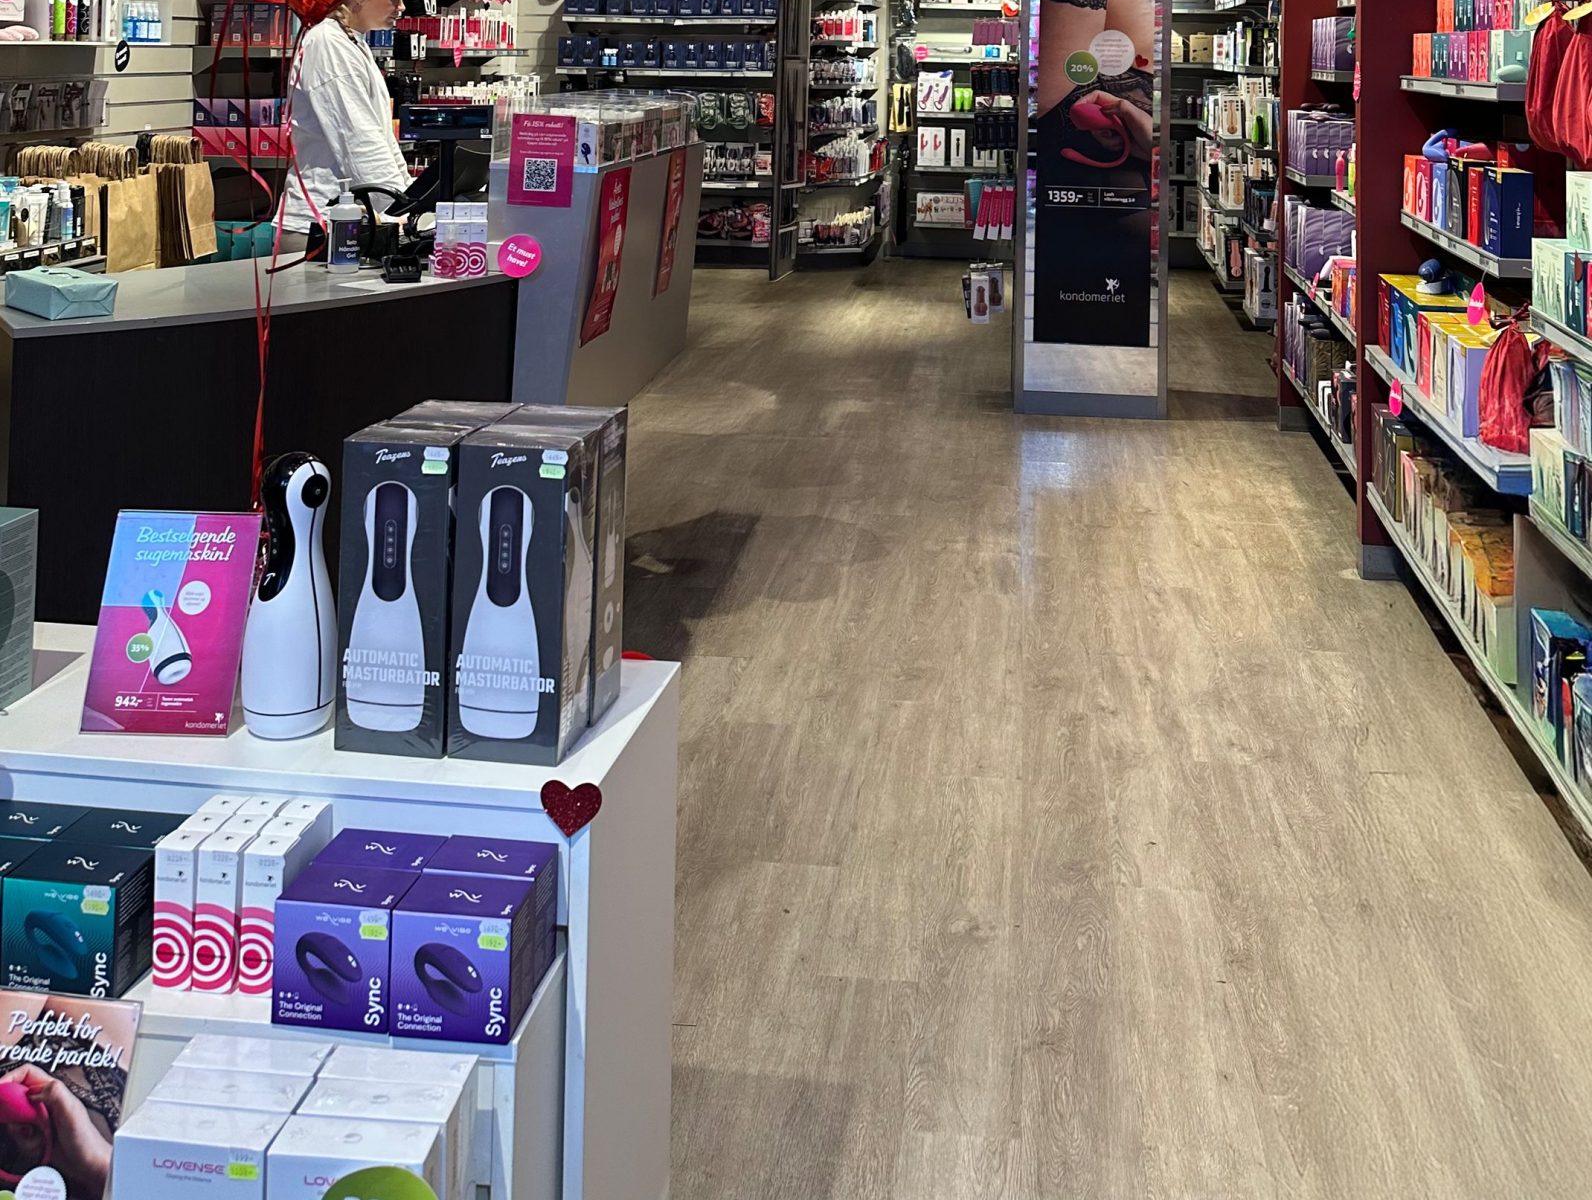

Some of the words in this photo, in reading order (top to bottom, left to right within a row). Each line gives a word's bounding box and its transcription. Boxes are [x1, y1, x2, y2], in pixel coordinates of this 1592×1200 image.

[1070, 64, 1094, 73] 20%
[1047, 190, 1084, 203] 1359,-
[507, 242, 517, 252] Et
[516, 248, 536, 260] must
[506, 253, 529, 268] have!
[1059, 290, 1126, 303] kondomeriet
[375, 448, 411, 465] Teazers
[490, 452, 528, 469] Teazers
[136, 526, 237, 548] Bestselgende
[135, 544, 235, 567] sugemaskin!
[343, 648, 419, 668] AUTOMATIC
[455, 653, 533, 674] AUTOMATIC
[342, 664, 440, 687] MASTURBATOR
[455, 670, 555, 694] MASTURBATOR
[185, 721, 227, 730] kondomeriet
[9, 973, 21, 984] The
[22, 975, 50, 986] Original
[90, 952, 110, 998] Sync
[279, 1000, 292, 1010] The
[294, 1002, 323, 1013] Original
[364, 976, 384, 1027] Sync
[278, 1010, 322, 1021] Connection
[397, 1013, 412, 1022] The
[413, 1014, 443, 1025] Original
[485, 987, 505, 1037] Sync
[8, 1010, 75, 1037] Perfekt
[73, 1012, 104, 1040] for
[397, 1021, 442, 1032] Connection
[50, 1043, 124, 1073] parlek!
[153, 1158, 226, 1175] LOVENSE
